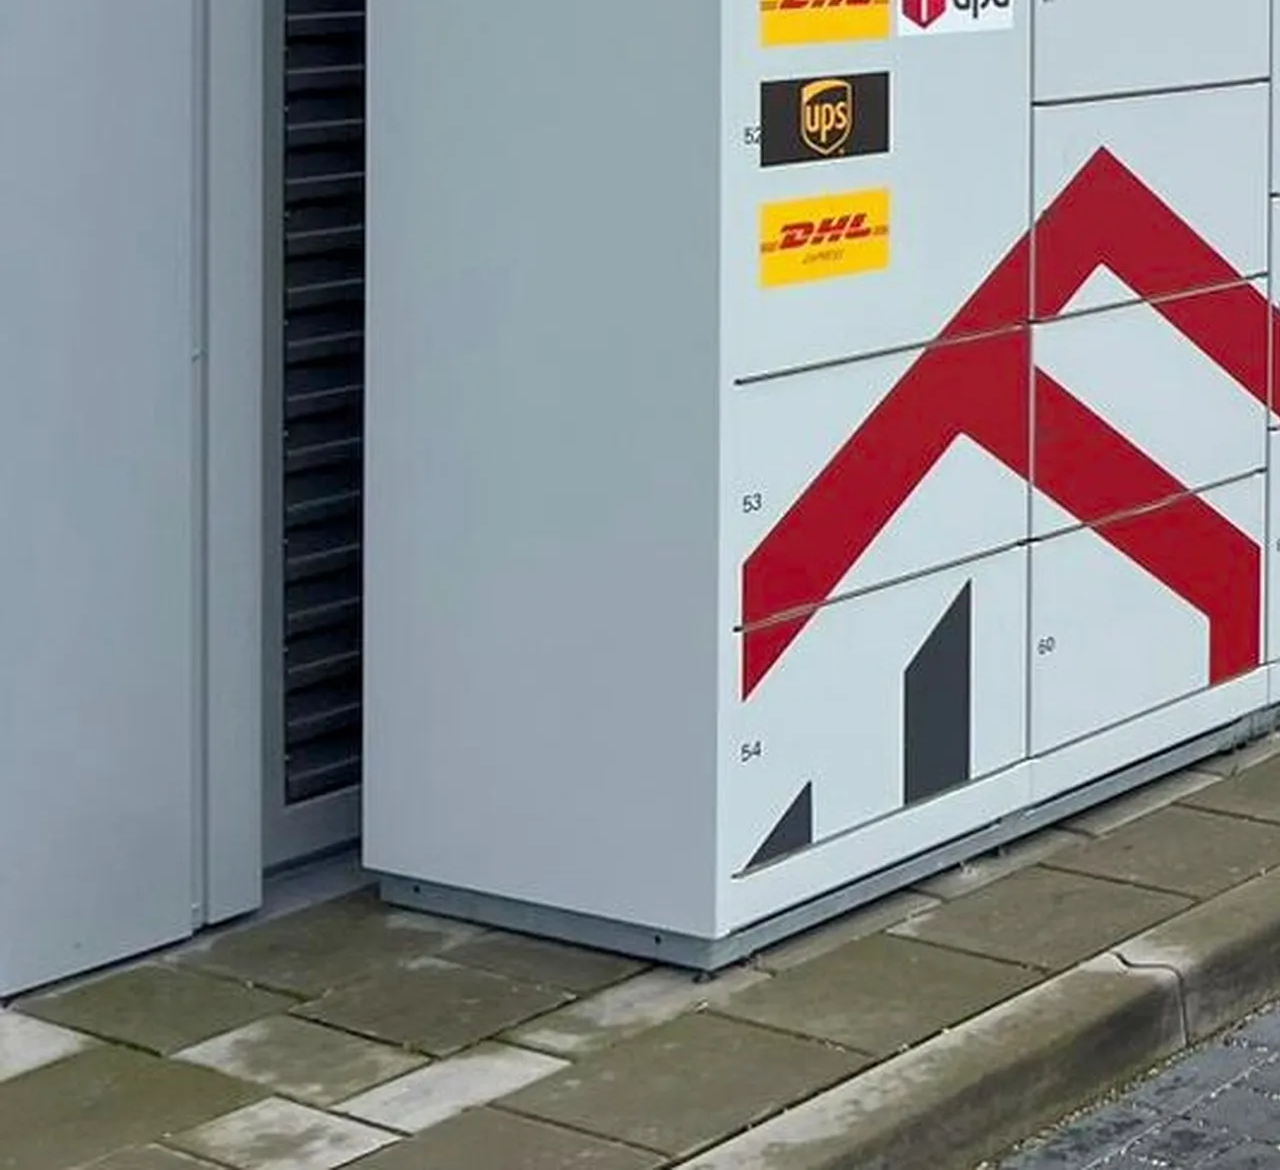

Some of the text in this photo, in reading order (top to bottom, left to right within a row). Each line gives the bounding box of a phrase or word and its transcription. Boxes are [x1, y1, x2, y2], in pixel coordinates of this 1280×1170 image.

[806, 101, 848, 143] ups
[779, 213, 871, 250] DHL
[742, 492, 762, 514] 53
[741, 740, 762, 763] 54
